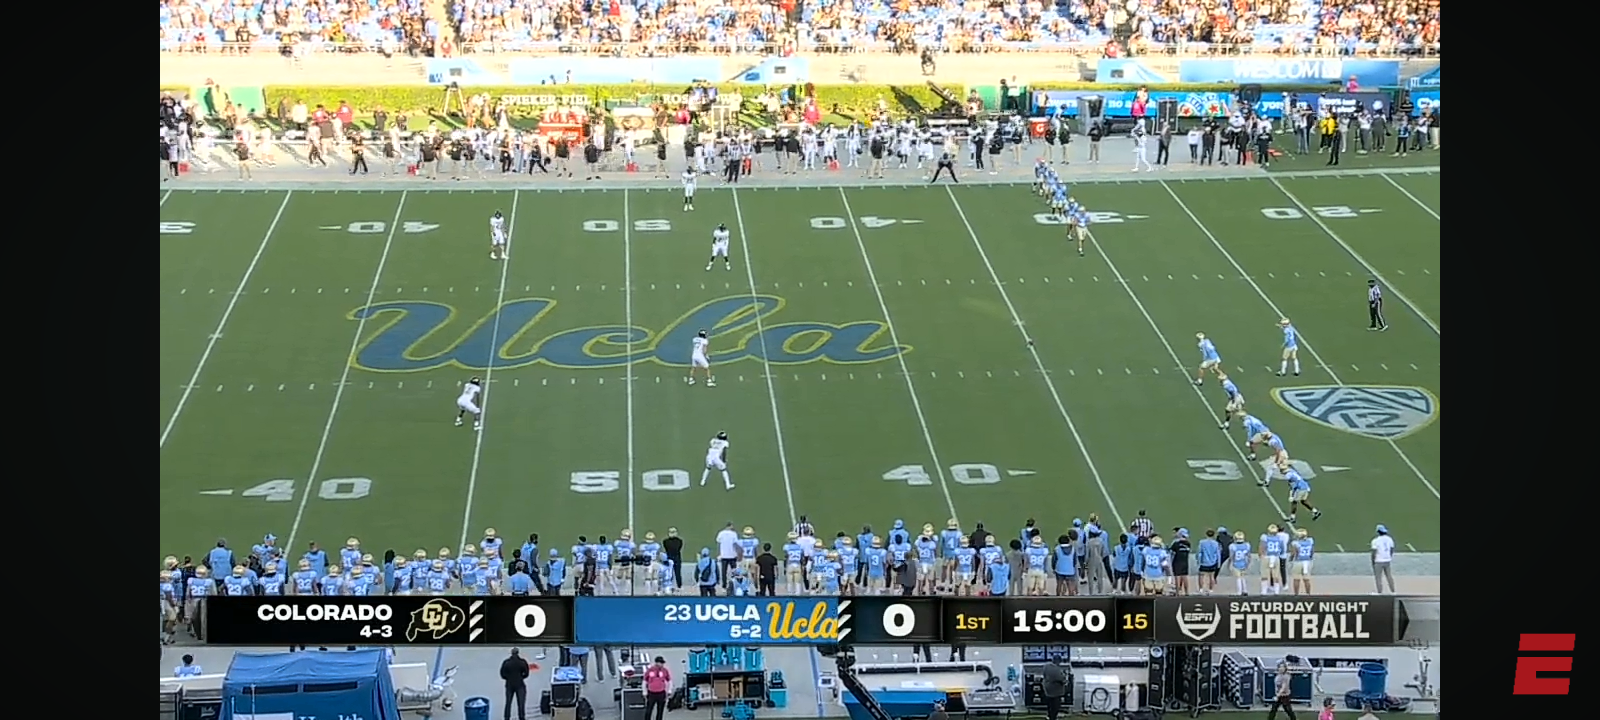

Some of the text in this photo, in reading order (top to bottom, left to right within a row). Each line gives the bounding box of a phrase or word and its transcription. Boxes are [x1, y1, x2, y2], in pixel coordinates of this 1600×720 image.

[1231, 60, 1321, 79] WESCOM
[501, 94, 591, 106] SPIEKER FIEL
[662, 94, 692, 104] ROS
[346, 294, 912, 373] Ucla
[569, 468, 691, 494] 50
[882, 463, 1002, 485] 40
[242, 476, 373, 503] 40
[227, 584, 242, 595] 23
